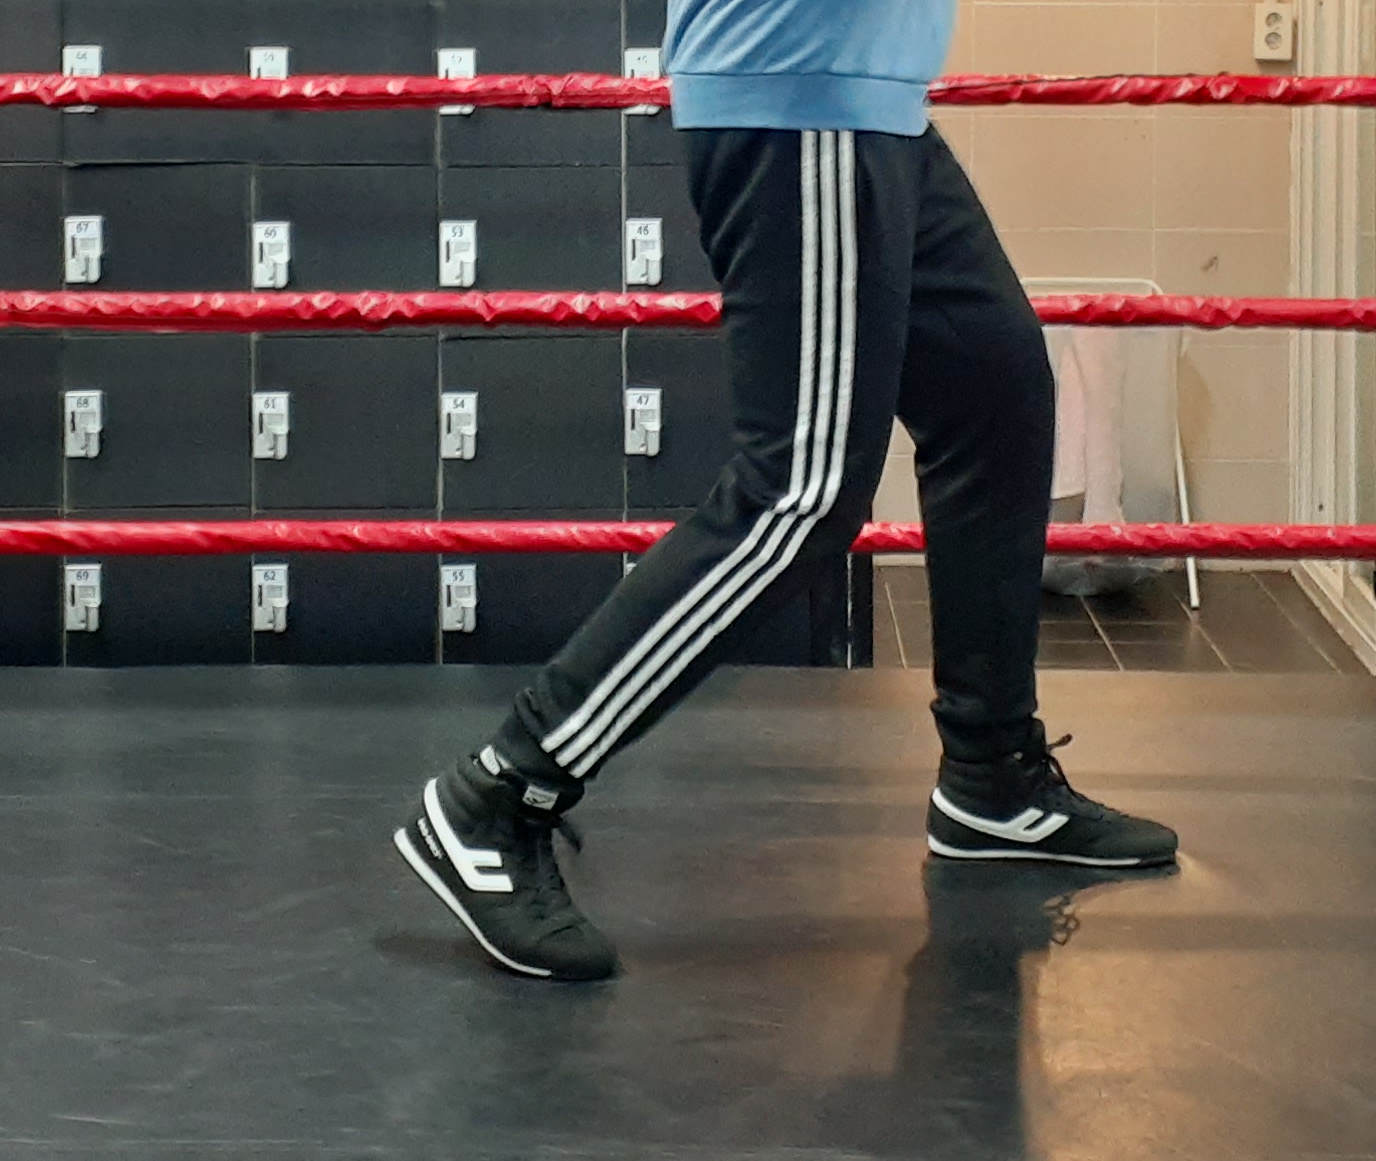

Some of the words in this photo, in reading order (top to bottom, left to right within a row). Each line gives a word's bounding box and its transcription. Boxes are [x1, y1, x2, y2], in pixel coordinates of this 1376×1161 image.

[263, 397, 277, 409] 61
[635, 394, 650, 407] 47
[75, 570, 90, 582] 69
[262, 570, 277, 582] 62
